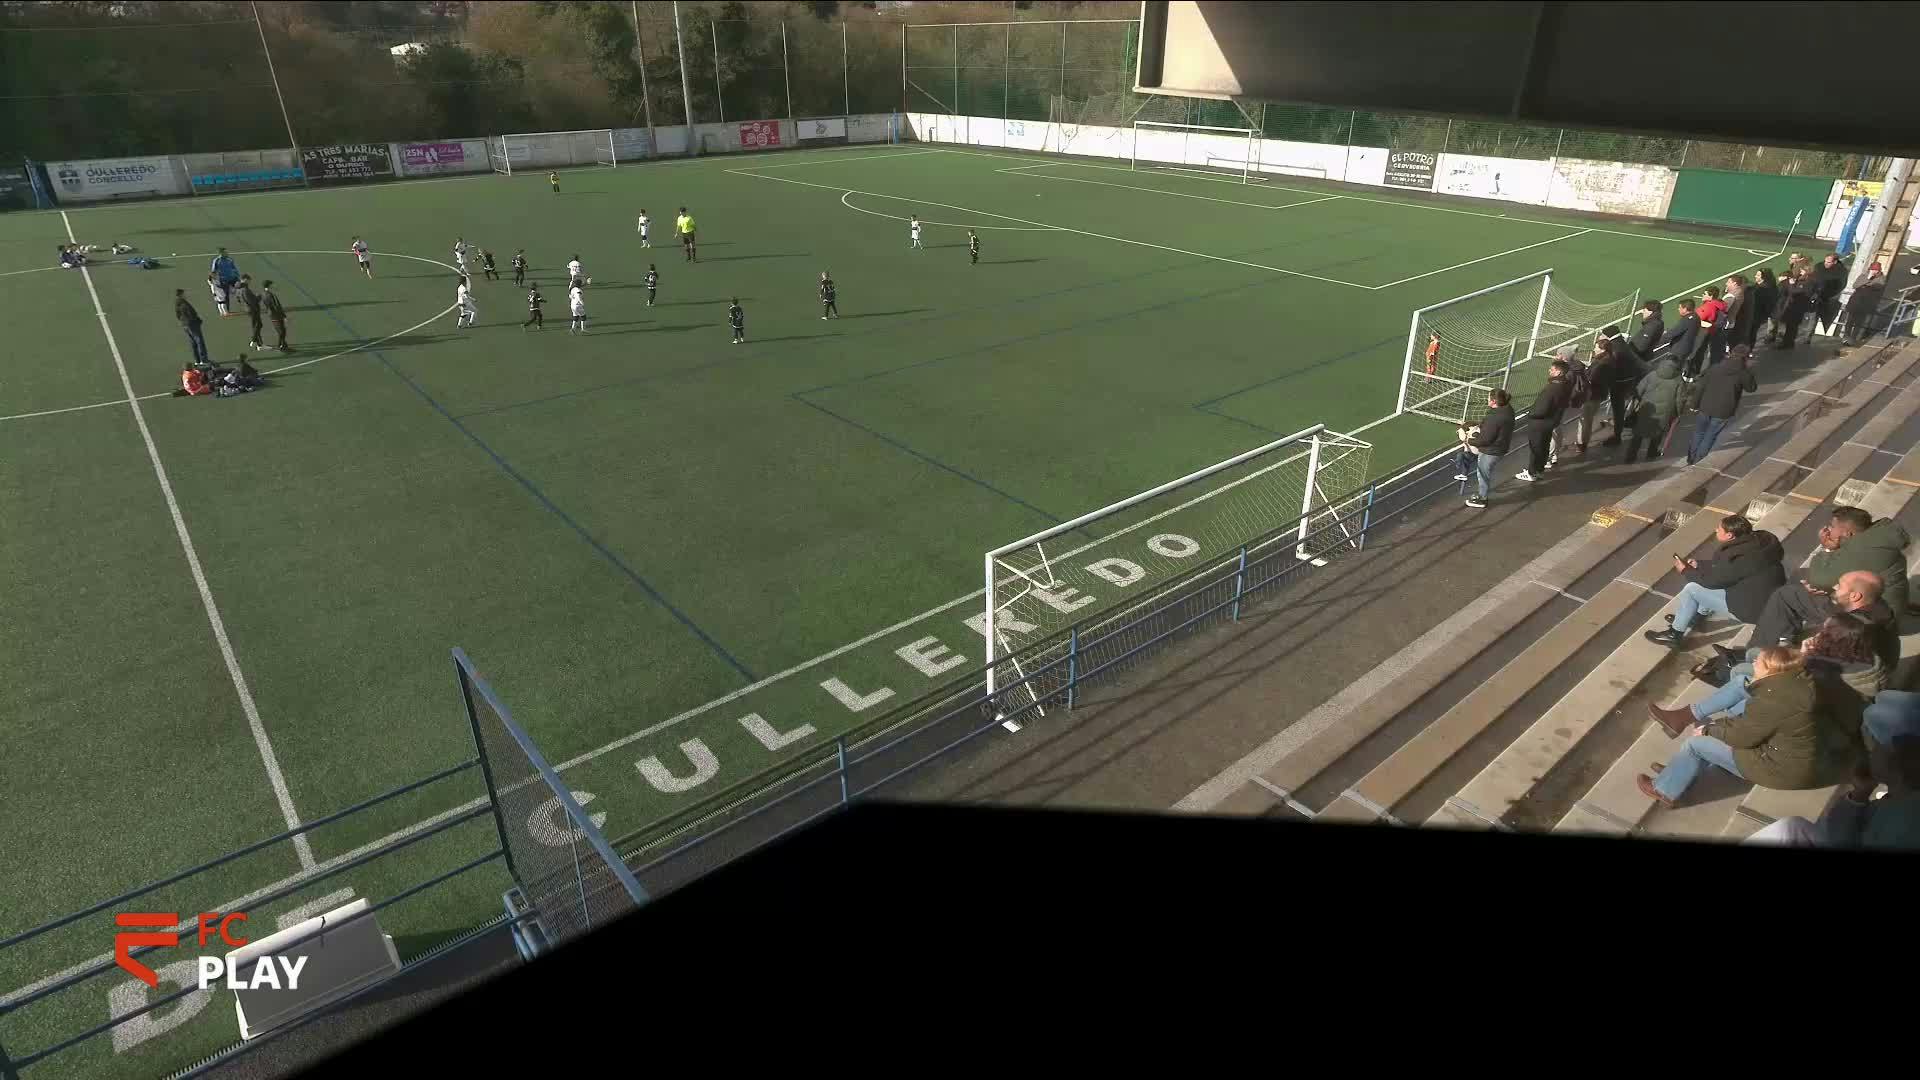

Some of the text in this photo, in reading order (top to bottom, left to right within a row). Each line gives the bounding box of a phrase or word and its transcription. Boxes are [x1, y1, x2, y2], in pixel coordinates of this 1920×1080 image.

[304, 145, 385, 161] AS TRES MARIAS
[406, 149, 424, 157] 25N
[1391, 152, 1434, 166] EL POTRO
[528, 533, 1200, 847] CULLEREDO
